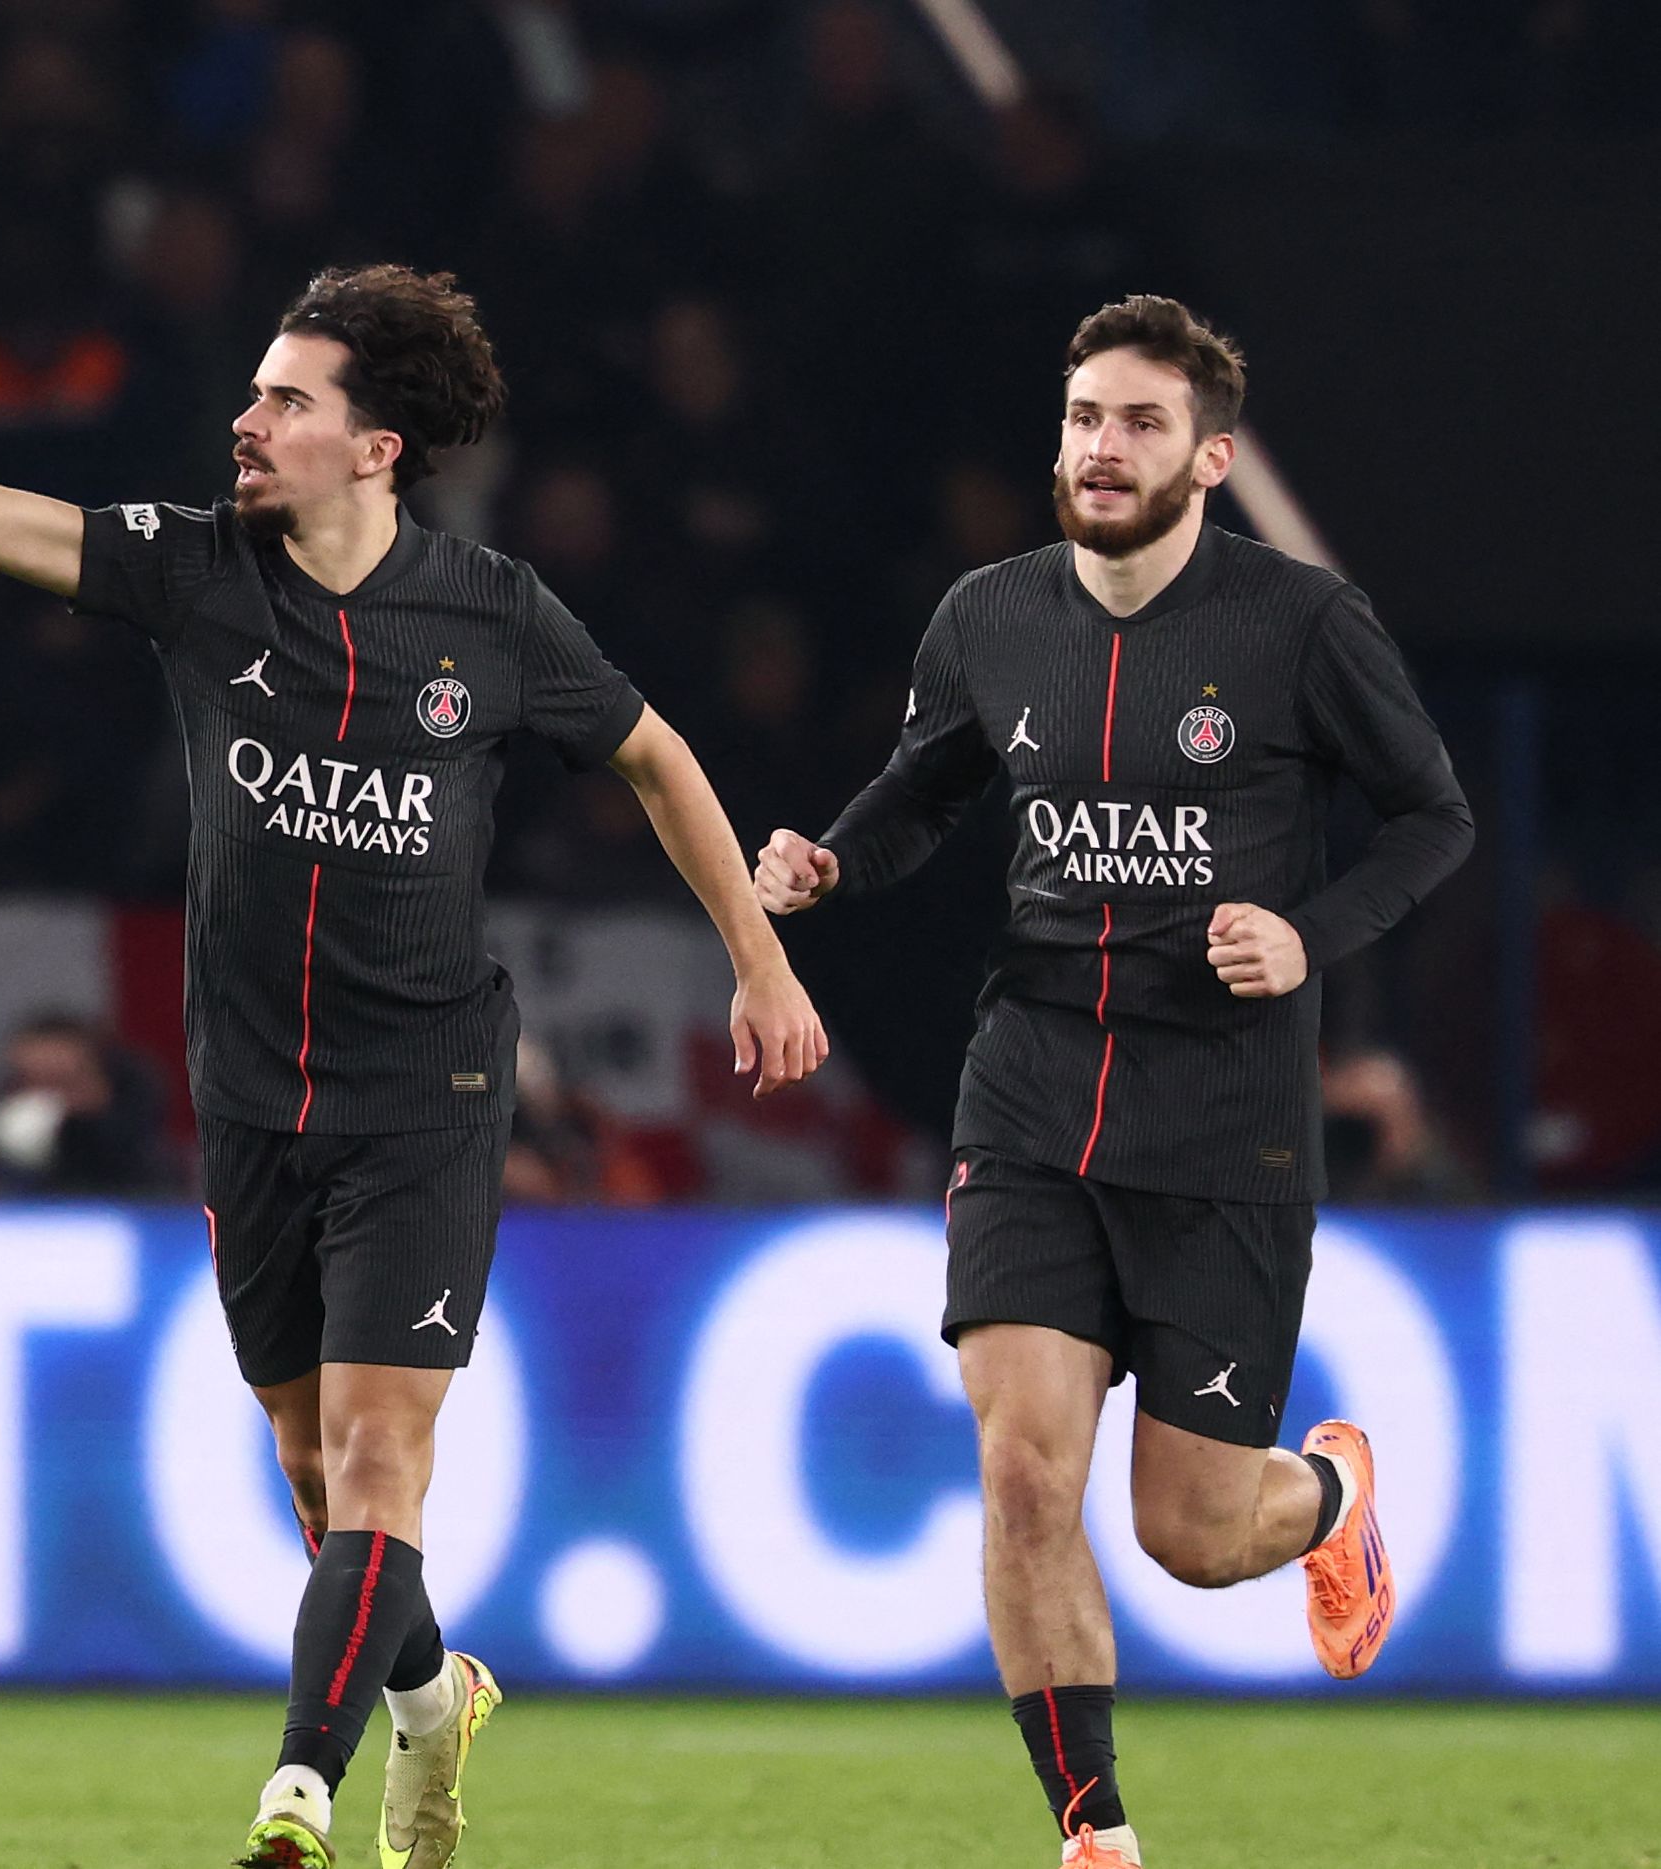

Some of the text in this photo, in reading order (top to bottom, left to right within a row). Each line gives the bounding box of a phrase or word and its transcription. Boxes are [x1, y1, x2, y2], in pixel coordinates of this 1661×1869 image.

[429, 681, 465, 699] PARIS
[1189, 708, 1226, 725] PARIS
[228, 737, 434, 822] QATAR
[264, 804, 430, 856] AIRWAYS
[1028, 798, 1213, 857] QATAR
[1062, 851, 1214, 886] AIRWAYS
[1350, 1583, 1390, 1671] F50
